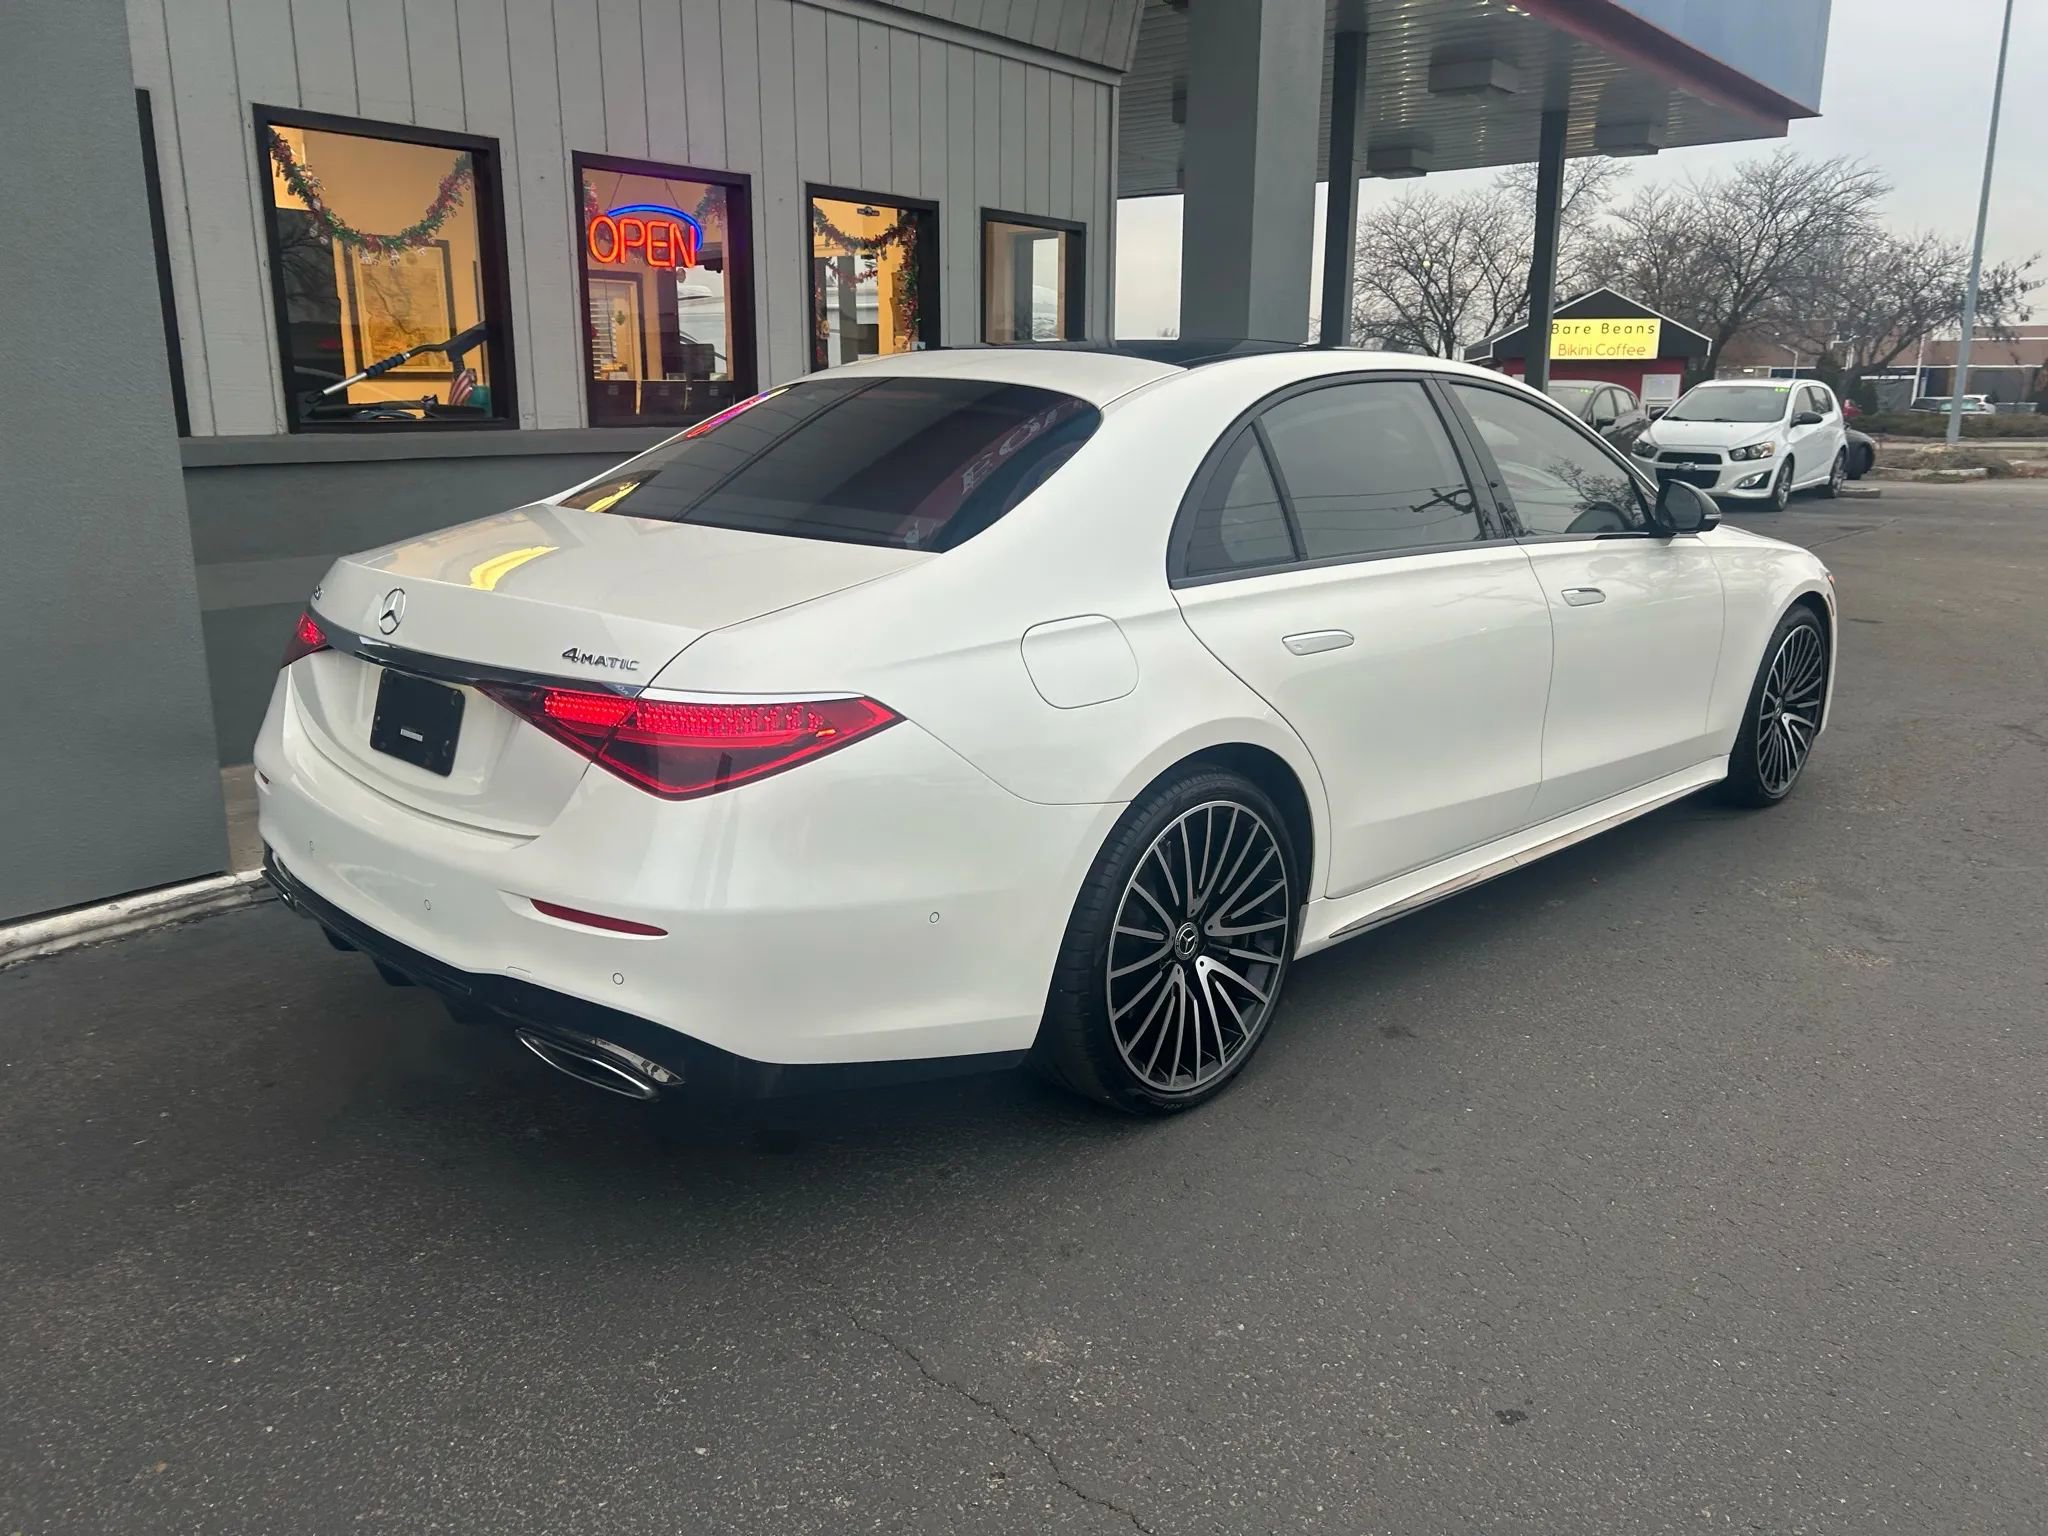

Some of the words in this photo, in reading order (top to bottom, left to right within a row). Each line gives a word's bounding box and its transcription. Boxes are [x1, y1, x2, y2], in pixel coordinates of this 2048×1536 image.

[588, 214, 697, 269] OPEN
[1551, 323, 1592, 335] Bare
[1601, 322, 1656, 335] Beans
[1558, 343, 1593, 357] Bikini
[1595, 343, 1646, 357] Coffee
[562, 647, 640, 671] 4MATIC
